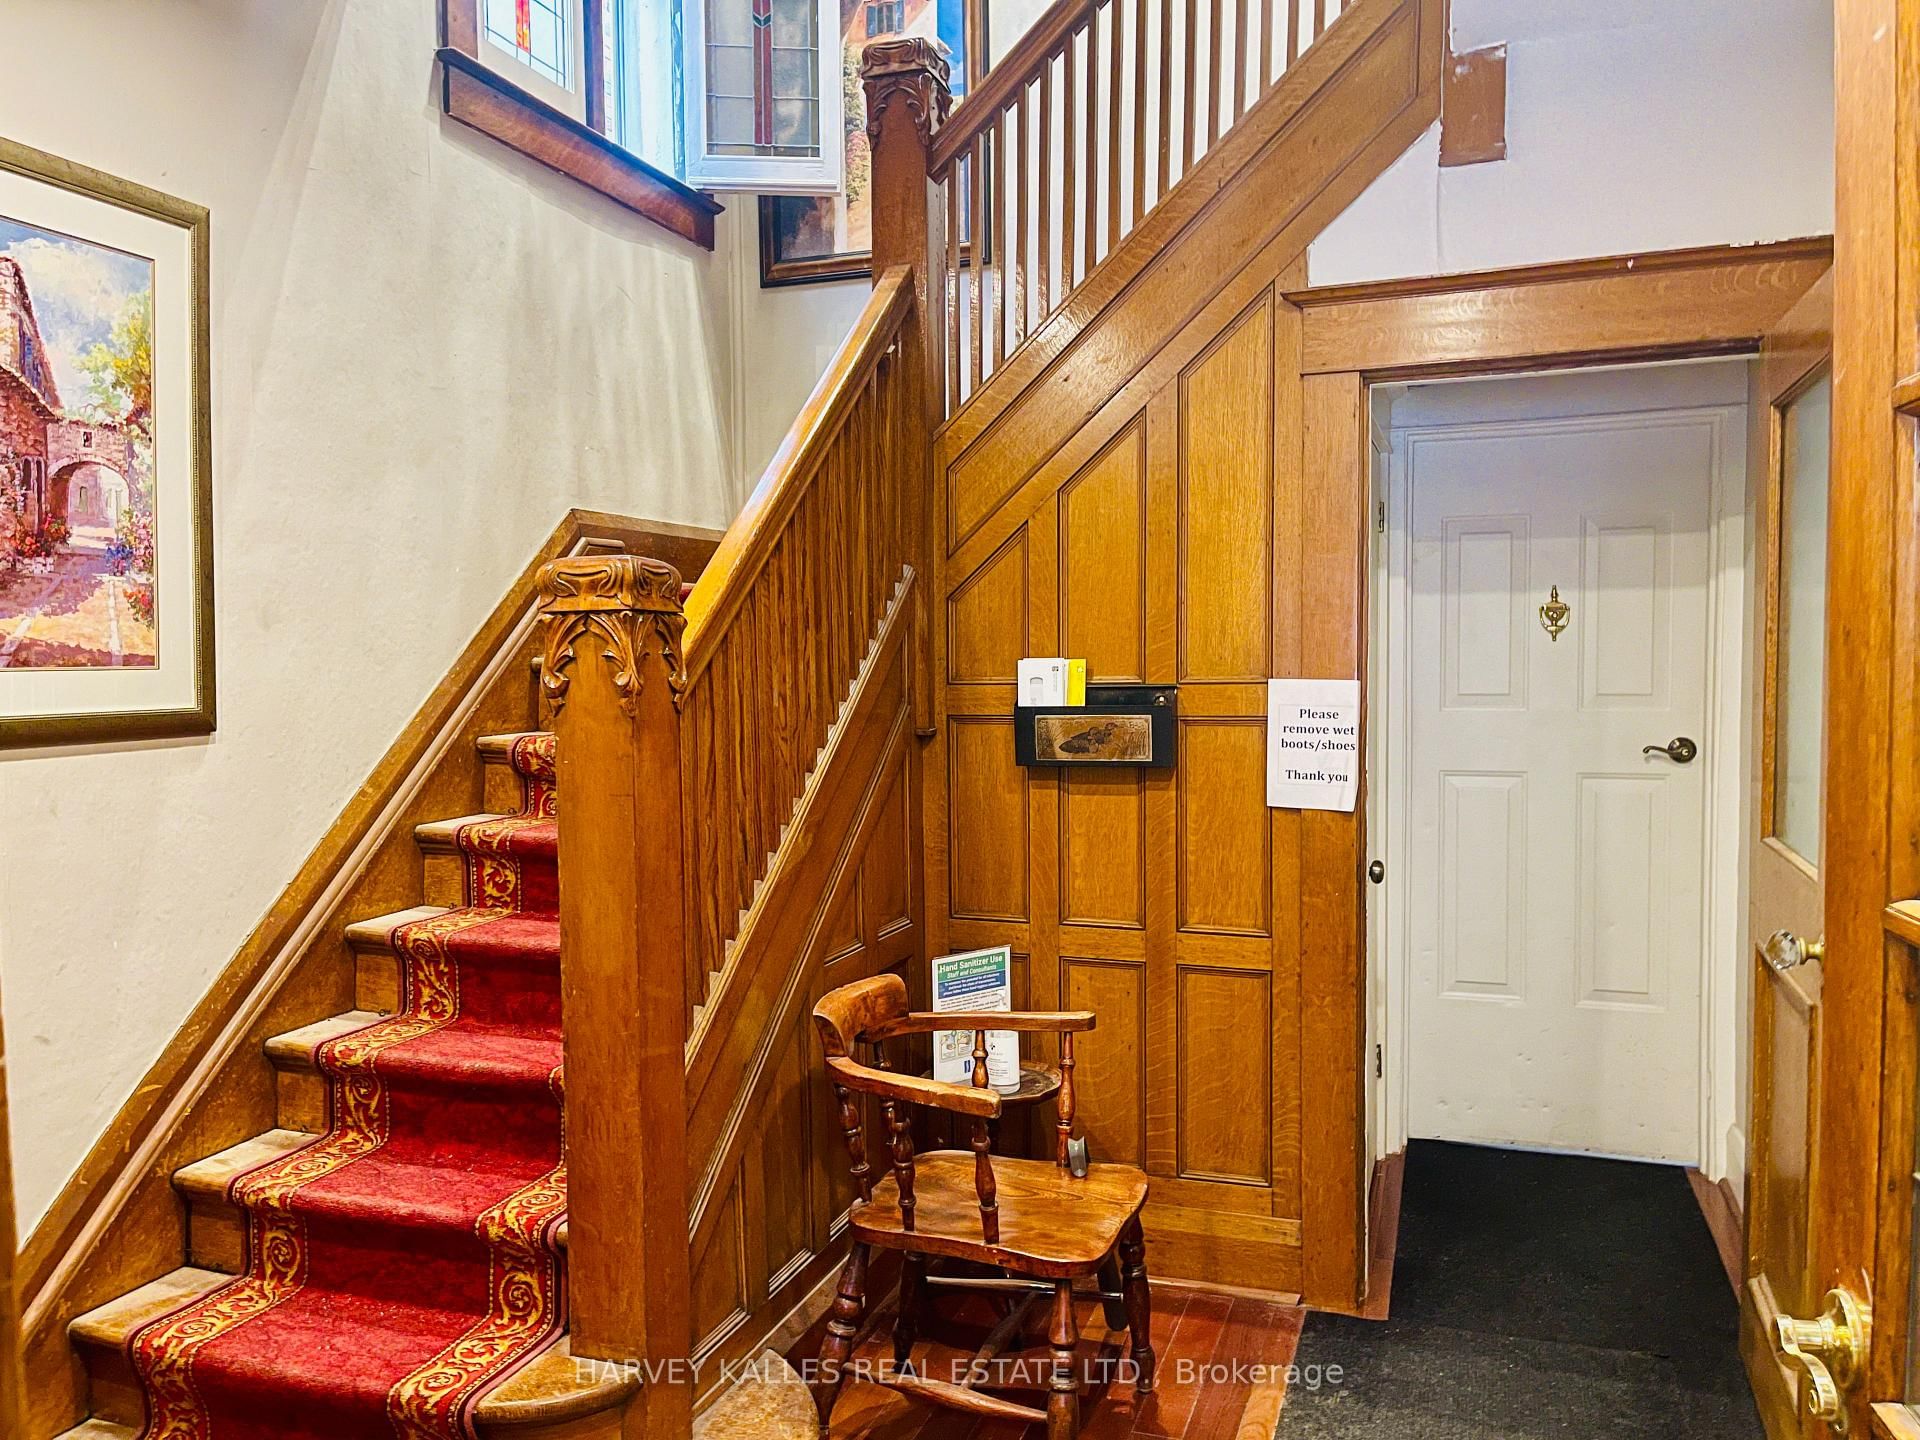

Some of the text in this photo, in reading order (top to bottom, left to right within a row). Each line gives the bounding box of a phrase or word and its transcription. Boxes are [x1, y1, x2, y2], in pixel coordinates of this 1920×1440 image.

[1299, 708, 1339, 720] Please
[1283, 725, 1355, 736] remove wet
[1281, 738, 1356, 752] boots/shoes
[1285, 769, 1348, 784] Thank you
[939, 955, 1003, 974] Hand Sanitizer Use
